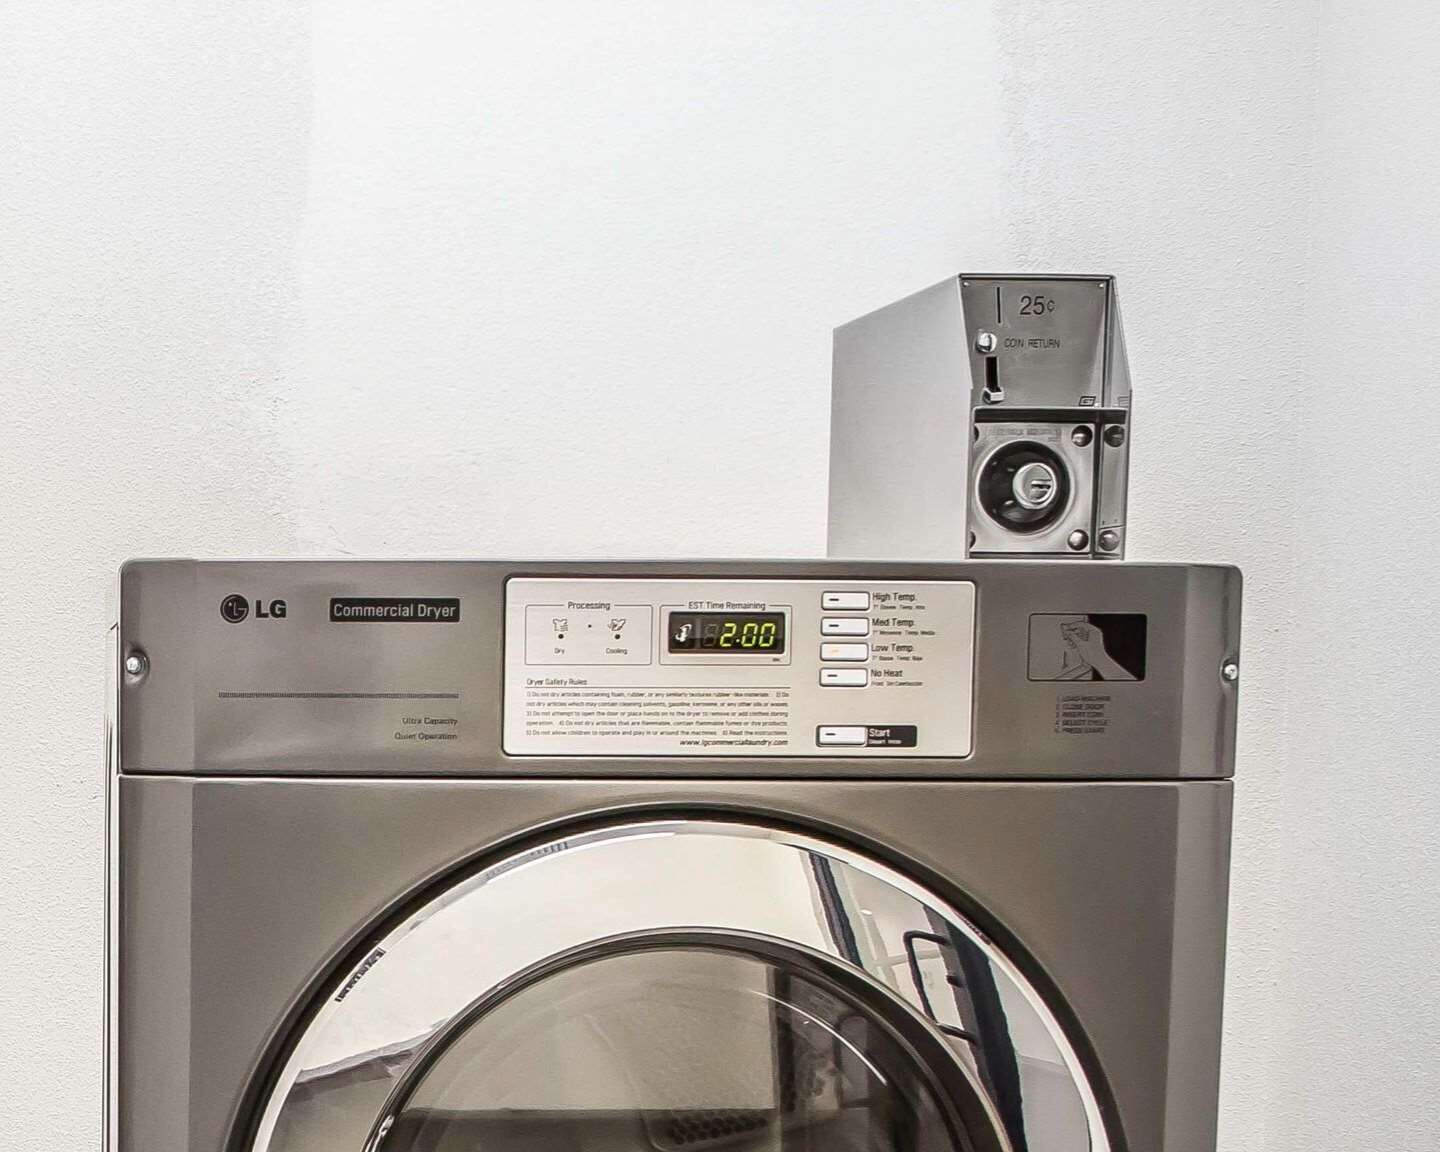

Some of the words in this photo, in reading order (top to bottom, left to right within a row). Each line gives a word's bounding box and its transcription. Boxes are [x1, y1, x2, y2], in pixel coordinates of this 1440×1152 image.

[1020, 295, 1056, 316] 25¢
[1004, 338, 1025, 349] COIN
[1028, 338, 1061, 349] RETURN
[872, 593, 890, 602] High
[255, 600, 287, 618] LG
[568, 602, 610, 611] Processing
[726, 602, 766, 611] Remaining
[334, 604, 413, 617] Commercial
[417, 604, 457, 619] Dryer
[872, 618, 889, 626] Med
[424, 718, 458, 726] Capacity
[418, 733, 458, 741] Operation
[869, 728, 890, 737] Start
